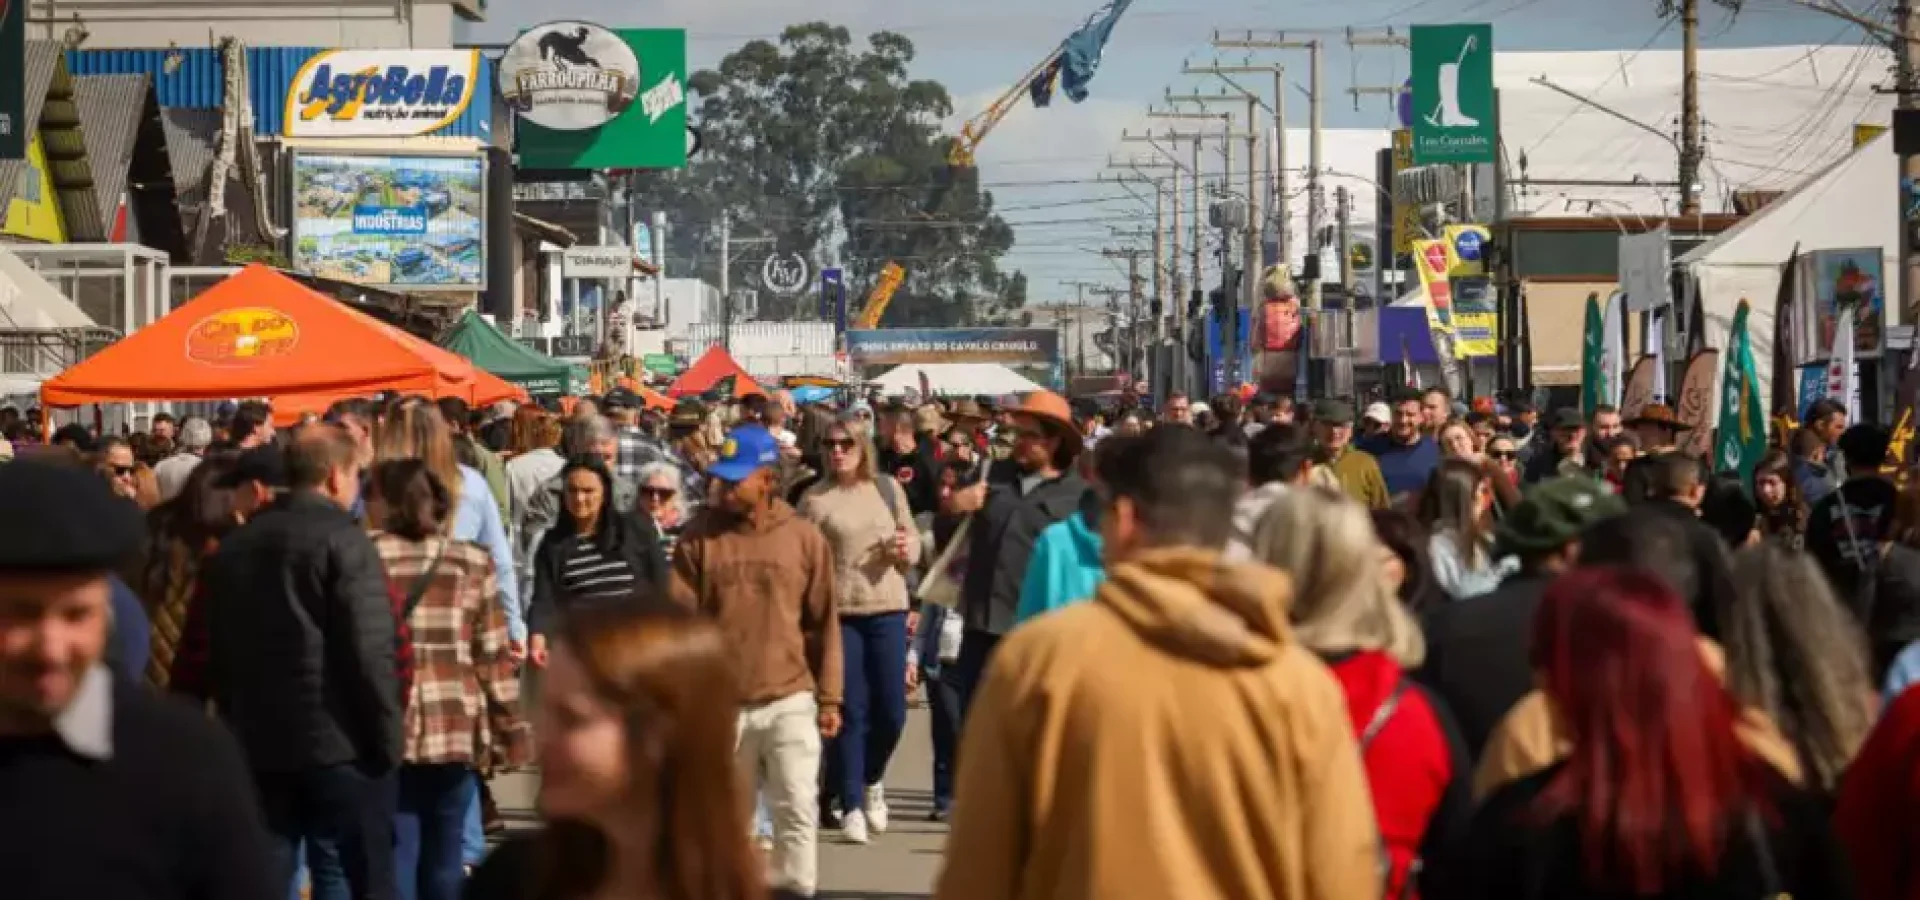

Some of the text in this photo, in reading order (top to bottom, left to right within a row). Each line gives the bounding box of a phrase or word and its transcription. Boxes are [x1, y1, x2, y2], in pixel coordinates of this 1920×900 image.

[305, 63, 466, 114] AgroBella
[519, 70, 619, 91] FARROUPILHA
[362, 107, 448, 121] nutrição animal
[934, 341, 949, 351] DO
[951, 340, 990, 351] CAVALO
